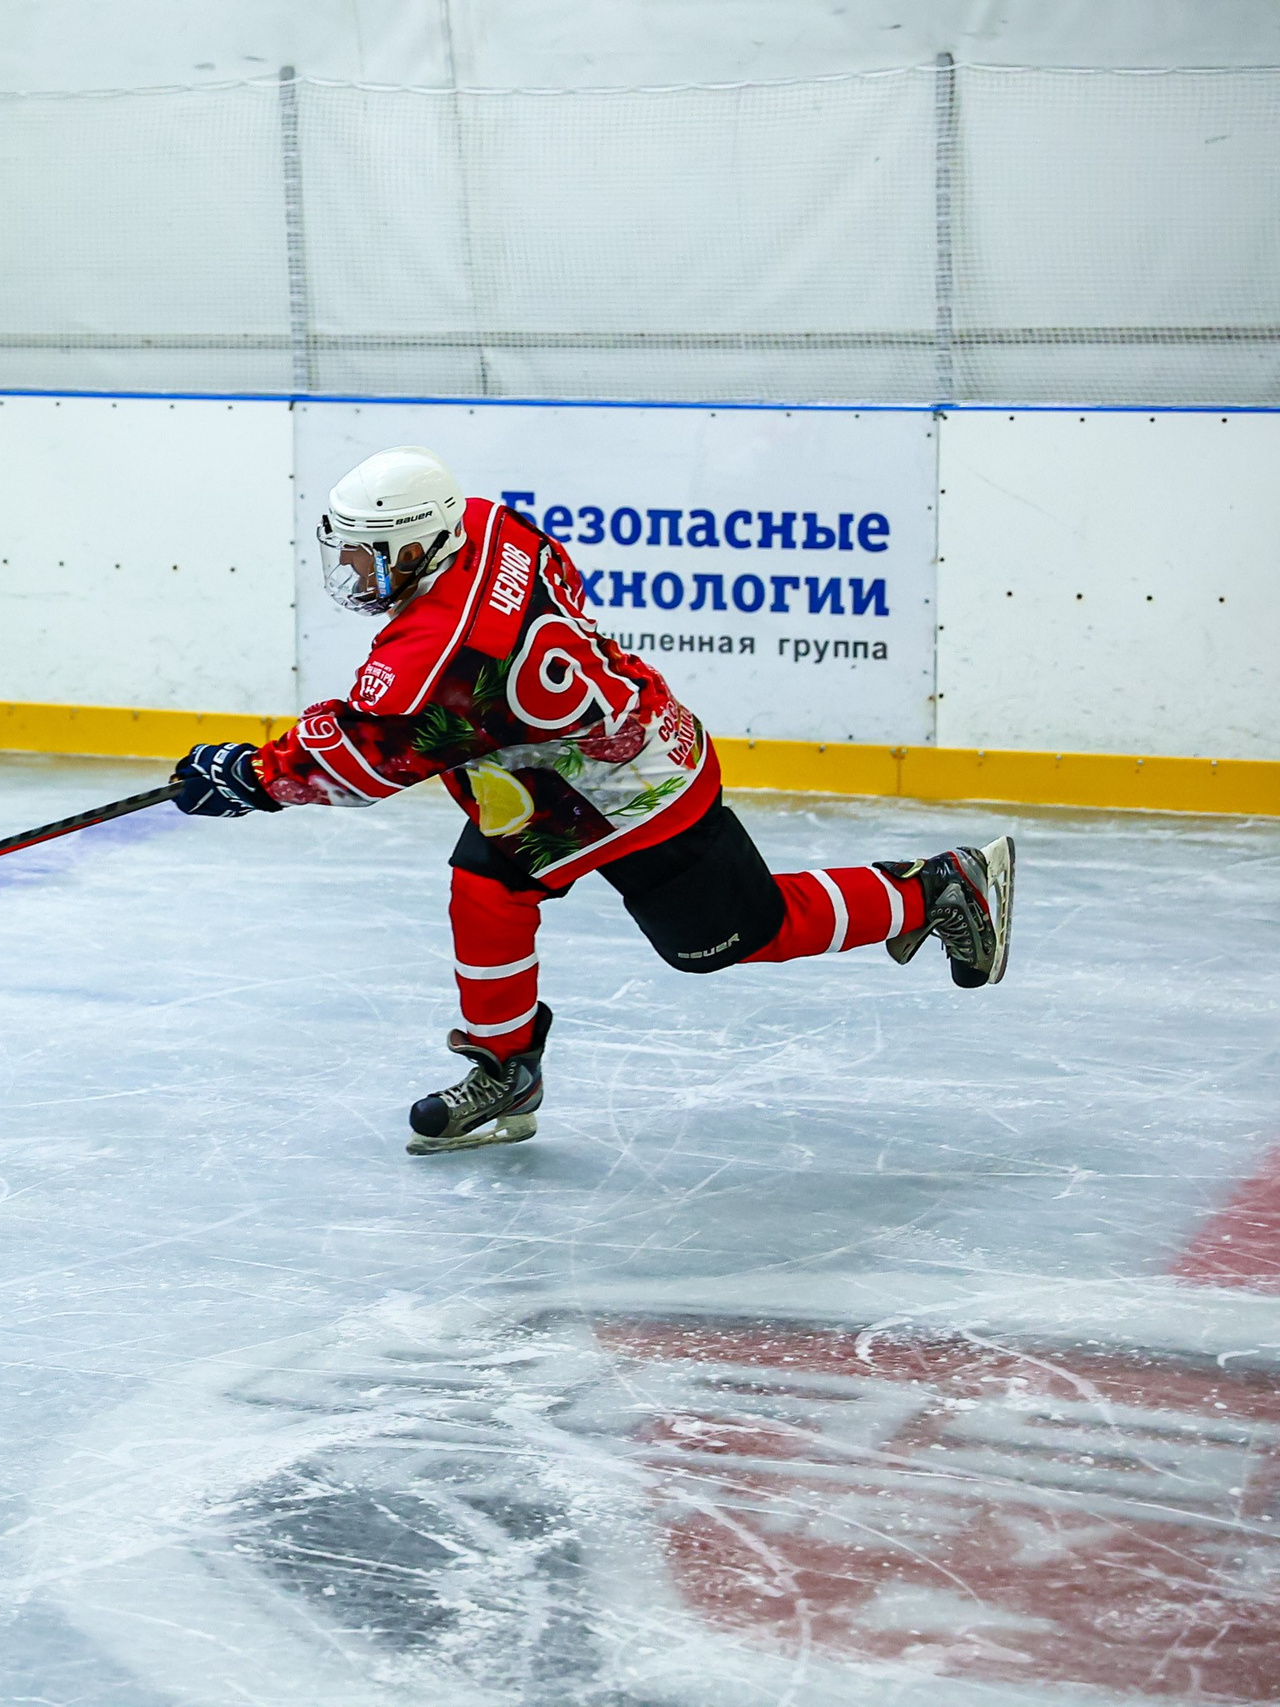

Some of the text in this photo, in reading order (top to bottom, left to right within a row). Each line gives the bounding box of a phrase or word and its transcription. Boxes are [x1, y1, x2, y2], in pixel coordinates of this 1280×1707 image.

[395, 510, 433, 526] BAUER
[501, 491, 890, 552] Безопасные
[489, 542, 532, 616] ЧЕРНОВ
[602, 631, 888, 663] шленная группа
